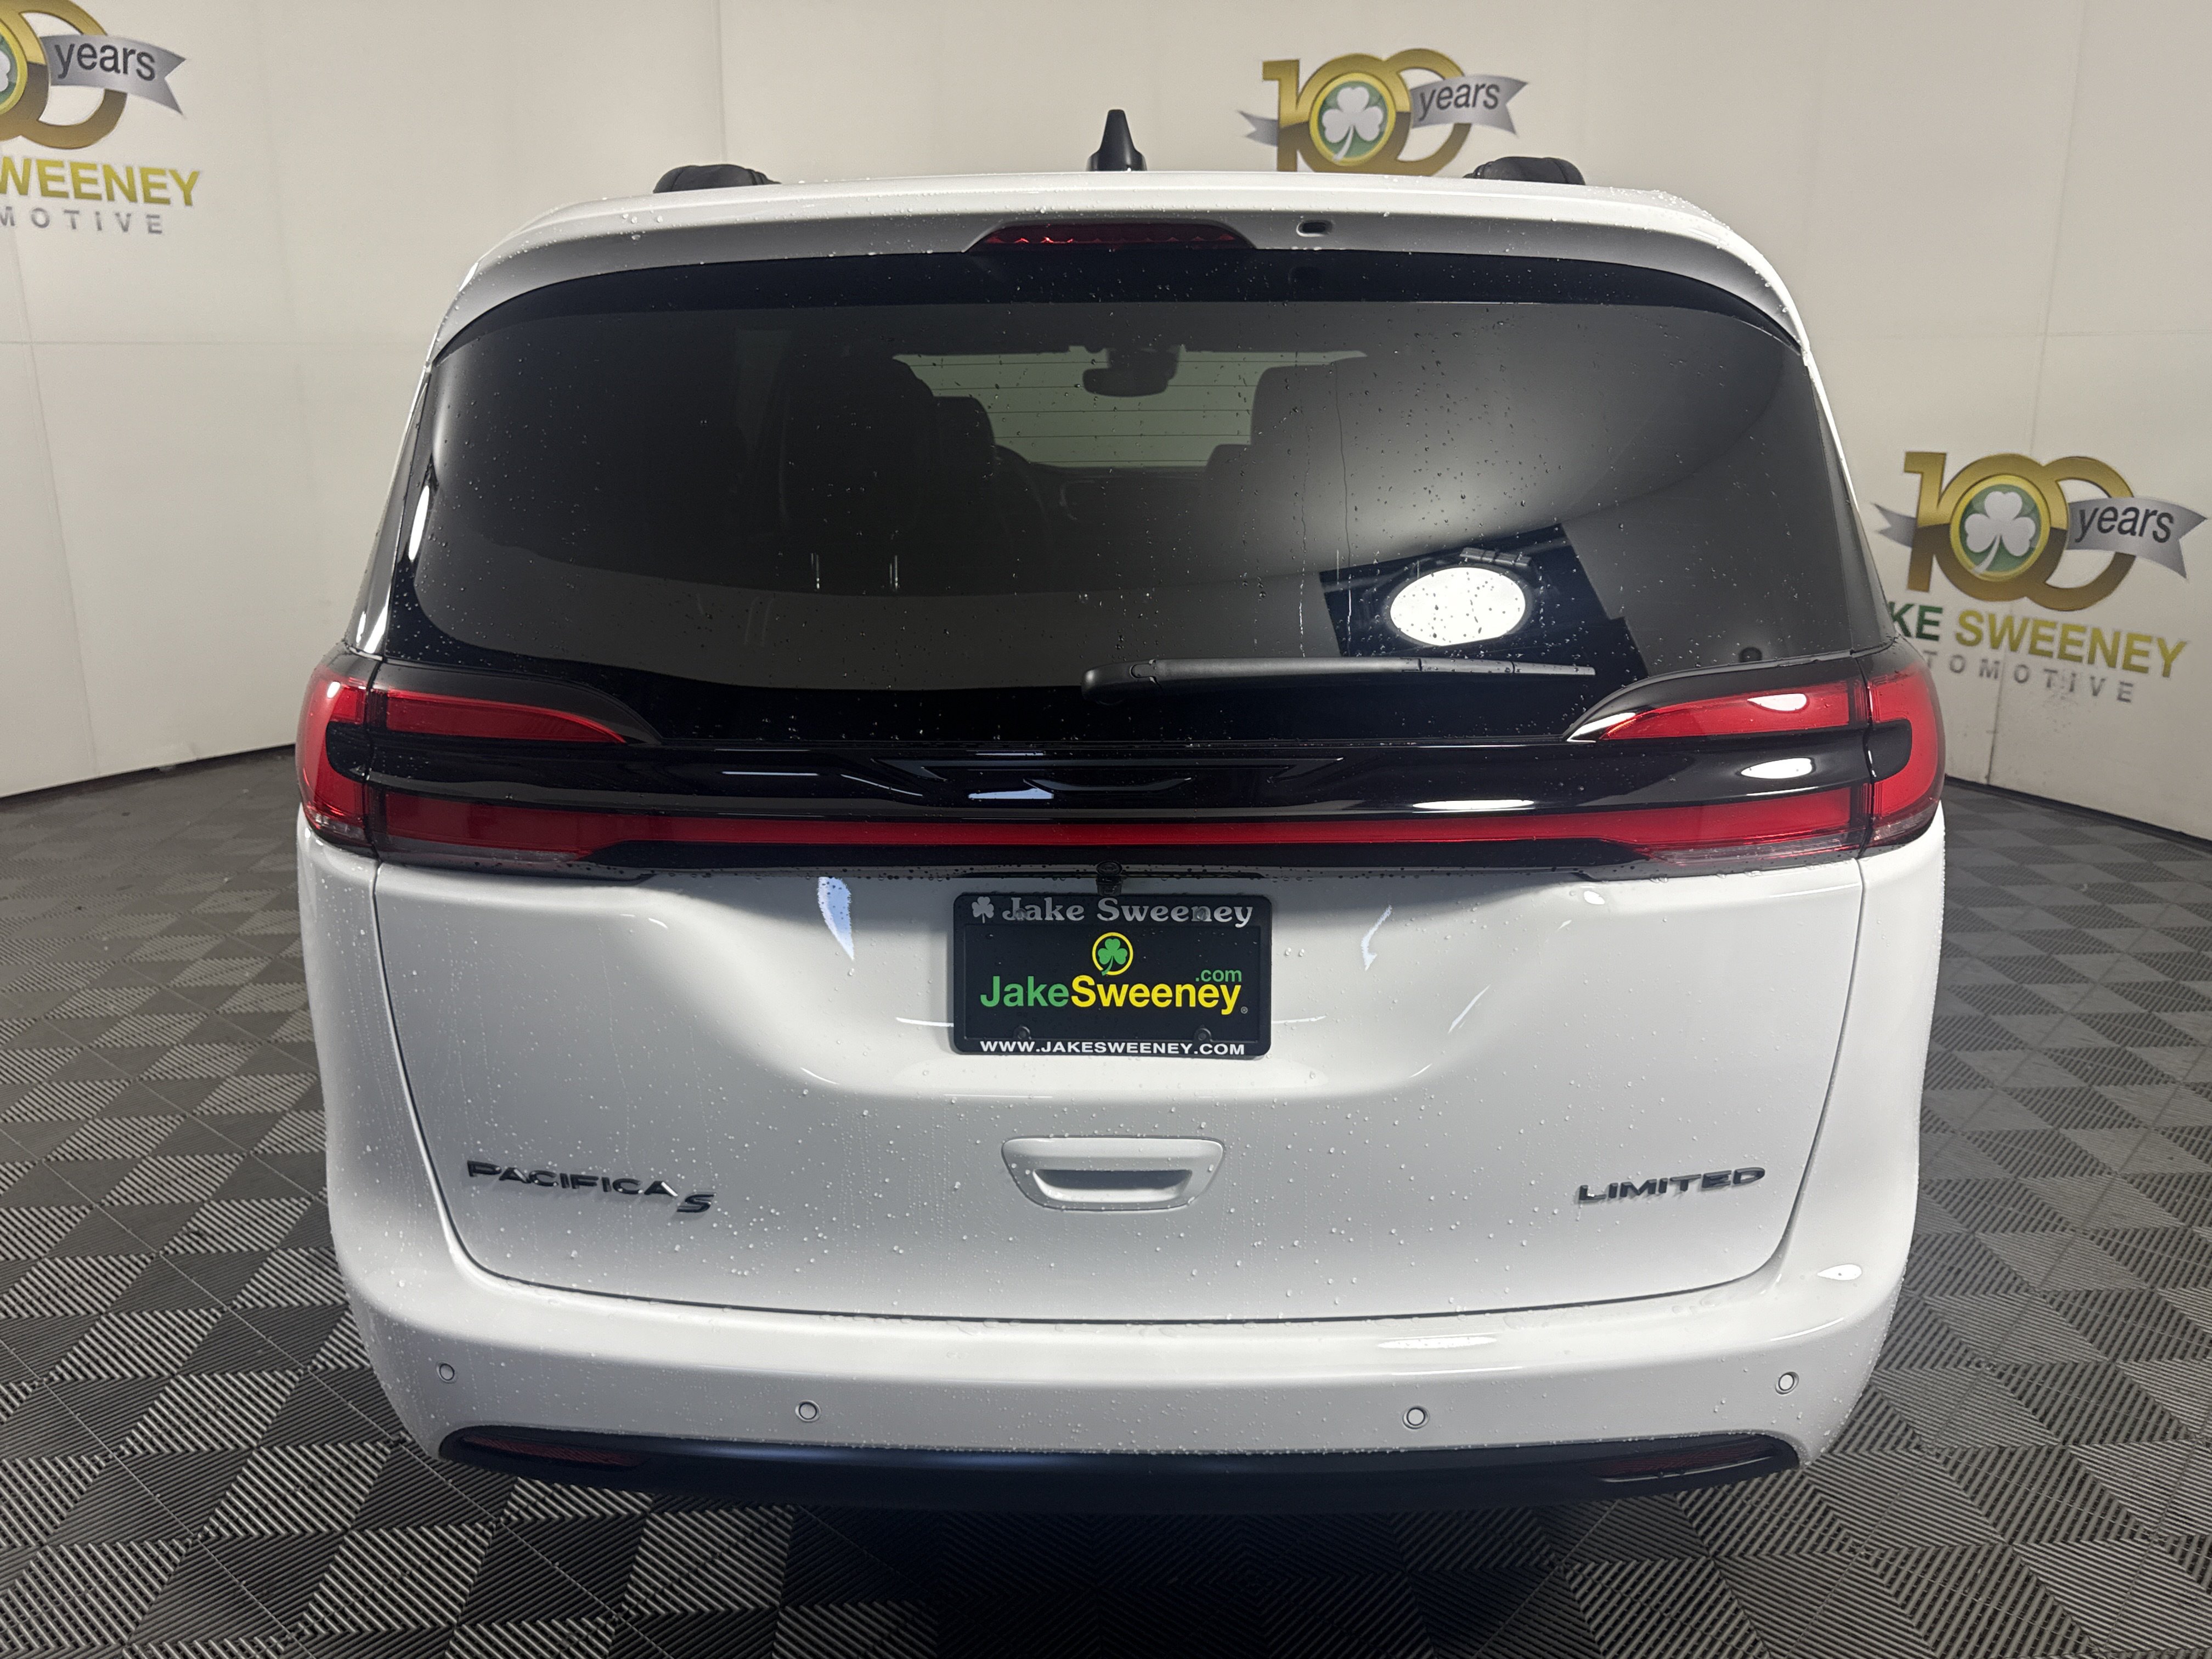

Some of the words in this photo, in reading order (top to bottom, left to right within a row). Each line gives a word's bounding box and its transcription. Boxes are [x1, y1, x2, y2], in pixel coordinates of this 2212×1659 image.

[54, 42, 155, 81] years
[1418, 82, 1500, 121] years
[2074, 505, 2174, 543] years
[1955, 610, 2188, 678] SWEENEY
[1002, 897, 1085, 922] Jake
[1097, 898, 1253, 928] Sweeney
[980, 1041, 1245, 1056] WWW.JAKESWEENEY.COM
[467, 1160, 679, 1197] PACIFICA
[676, 1192, 716, 1213] S
[1578, 1166, 1765, 1201] LIMITED
